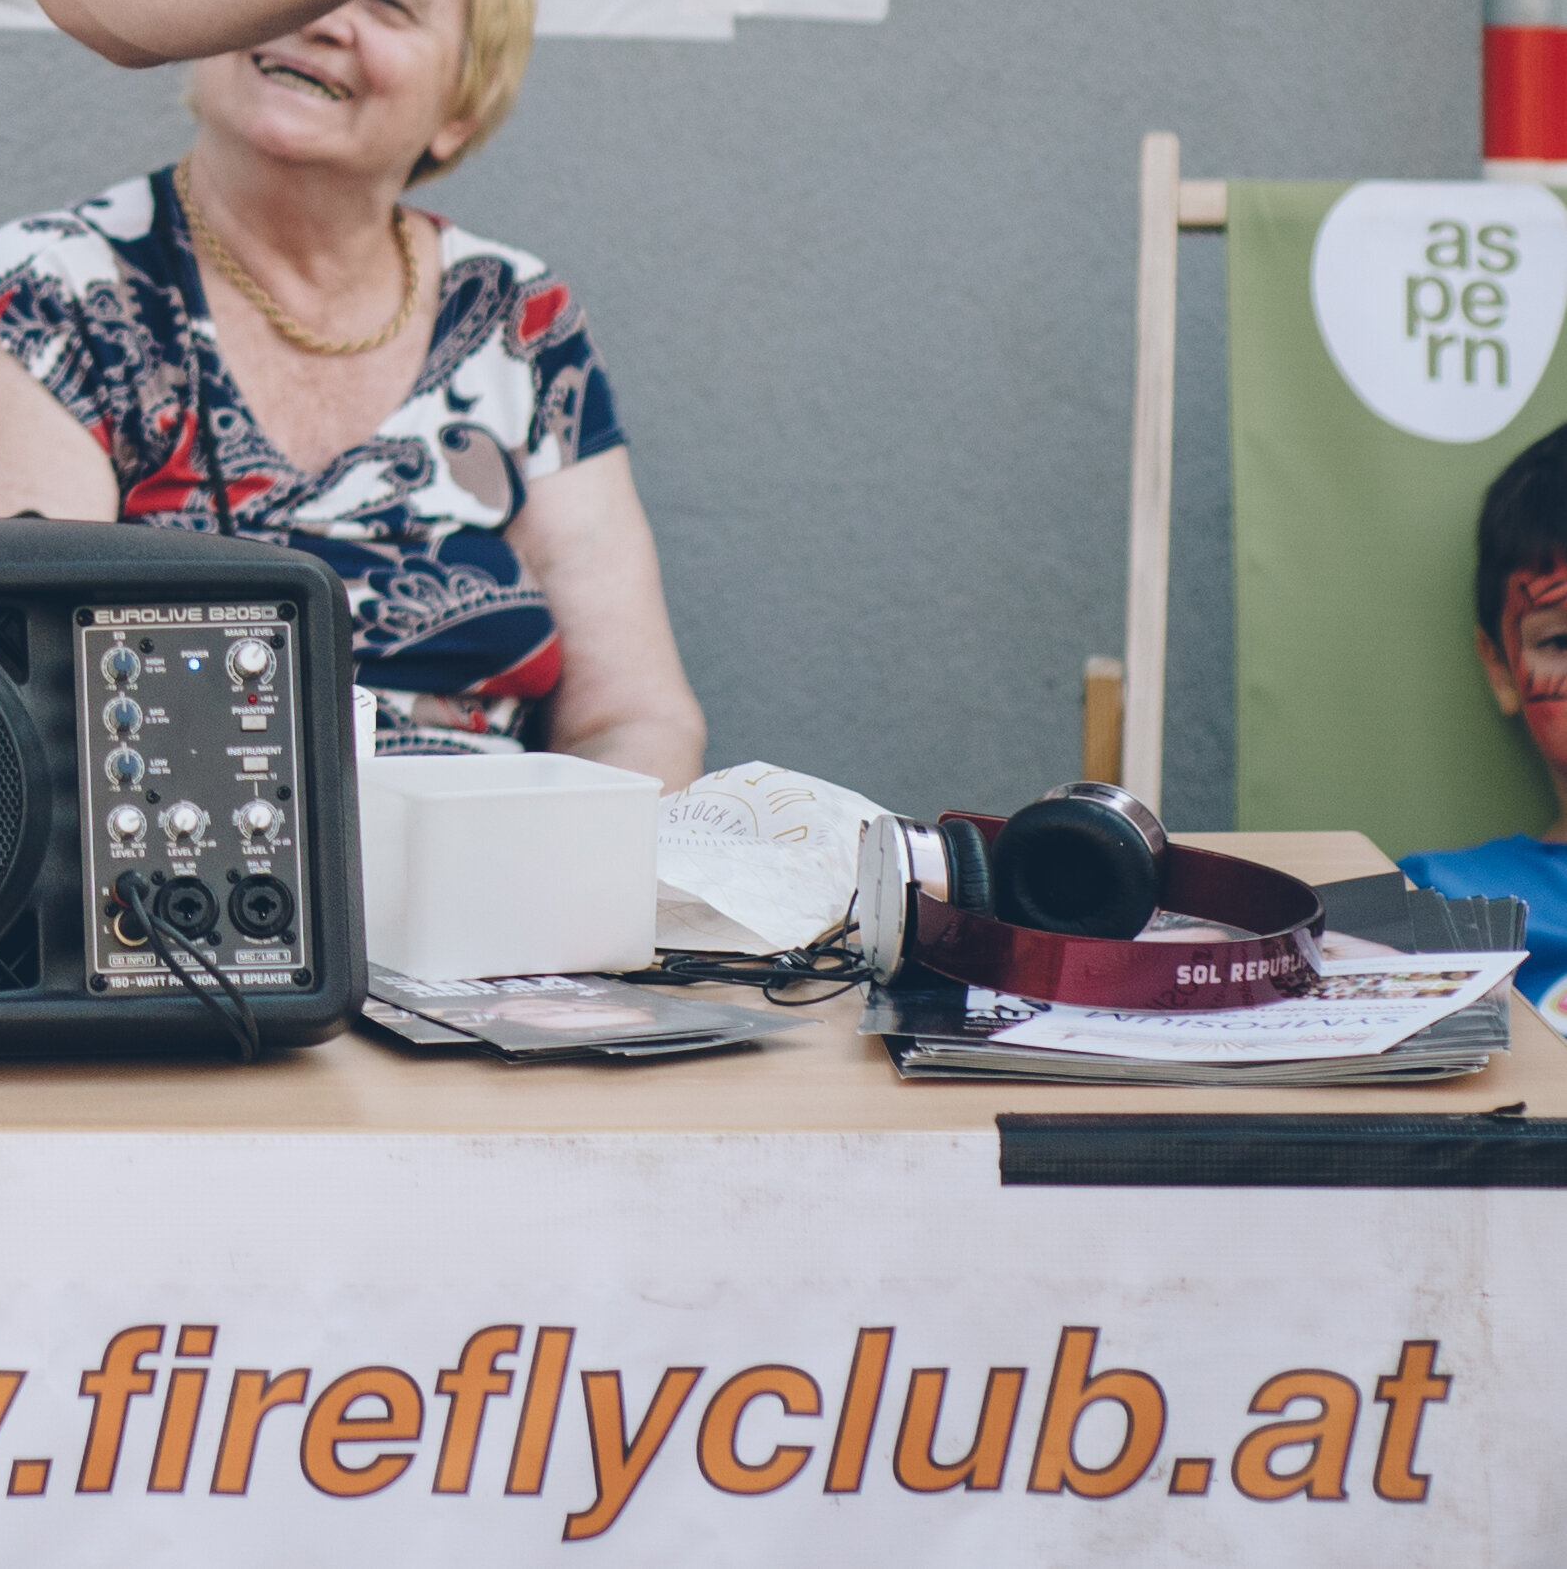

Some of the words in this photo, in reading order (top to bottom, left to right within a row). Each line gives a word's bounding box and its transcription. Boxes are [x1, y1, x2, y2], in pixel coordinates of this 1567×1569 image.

[1423, 218, 1521, 276] as
[1405, 274, 1508, 339] pe
[1424, 336, 1510, 389] rn
[94, 607, 203, 624] EUROLIVE
[209, 606, 278, 621] B205D
[225, 628, 248, 637] MAIN
[250, 628, 275, 637] LEVEL
[181, 650, 209, 658] POWER
[231, 706, 275, 715] PHANTOM
[226, 746, 282, 756] INSTRUMENT
[111, 850, 136, 858] LEVEL
[167, 848, 193, 856] LEVEL
[242, 846, 268, 855] LEVEL
[110, 976, 167, 988] 150-WATT
[243, 973, 292, 985] SPEAKER
[1176, 965, 1222, 986] SOL
